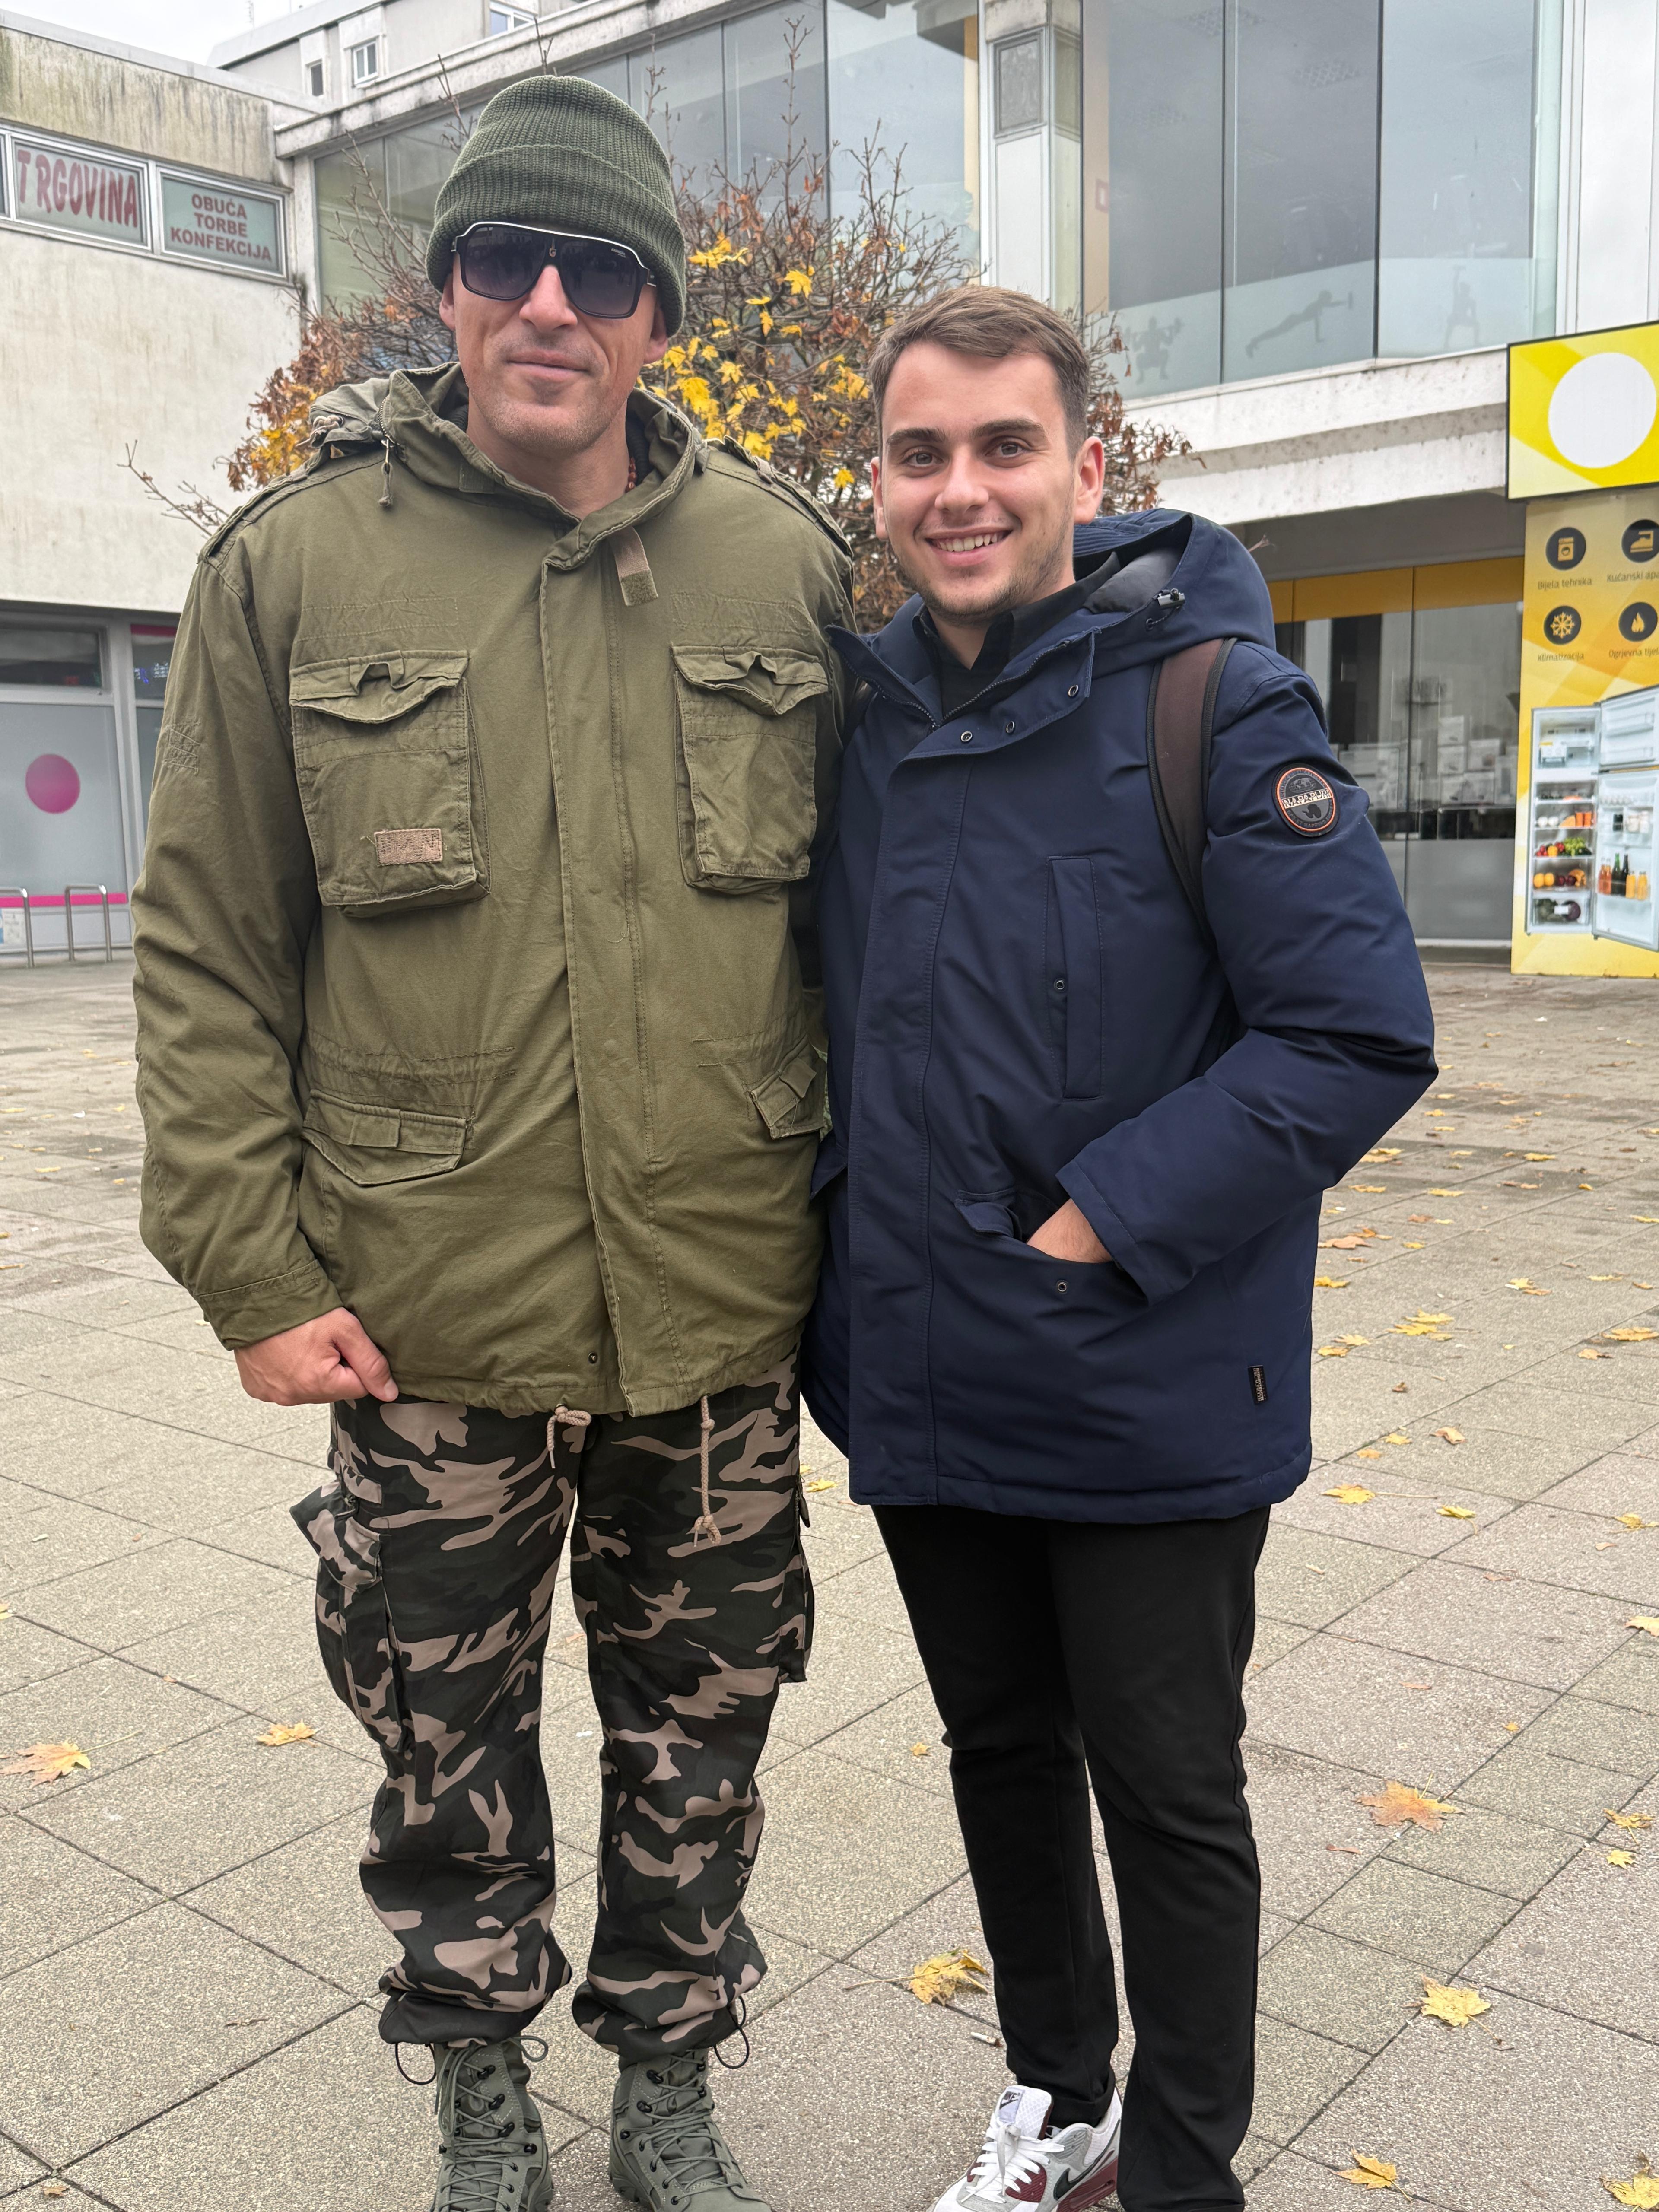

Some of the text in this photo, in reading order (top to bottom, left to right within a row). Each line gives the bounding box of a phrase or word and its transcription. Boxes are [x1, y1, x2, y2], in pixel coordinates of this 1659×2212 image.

[18, 149, 137, 228] TRGOVINA
[191, 194, 247, 219] OBUĆA
[194, 212, 248, 238] TORBE
[171, 227, 272, 261] KONFEKCIJA
[1538, 577, 1592, 591] Bijela tehnika
[1607, 571, 1643, 583] Kućanski
[1538, 652, 1584, 662] Klimatizacija
[1608, 647, 1659, 660] Ogrjevna tijel
